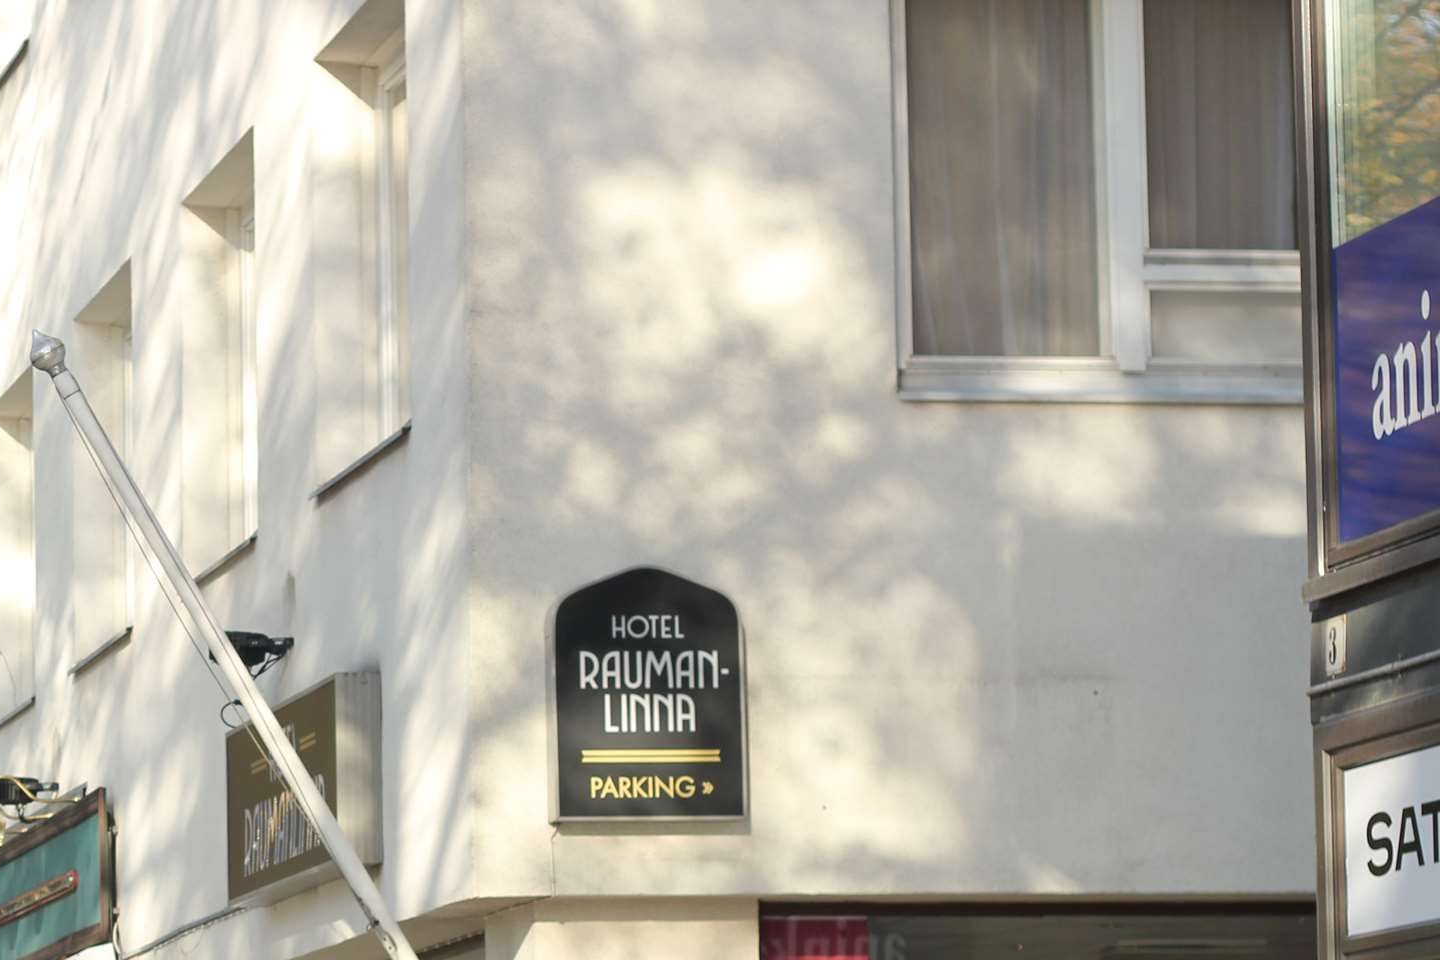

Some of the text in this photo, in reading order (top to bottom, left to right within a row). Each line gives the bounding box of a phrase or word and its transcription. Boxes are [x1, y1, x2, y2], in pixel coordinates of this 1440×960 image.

[611, 614, 685, 639] HOTEL
[1328, 626, 1338, 666] 3
[578, 650, 730, 690] RAUMAN-
[603, 693, 697, 733] LINNA
[589, 776, 696, 799] PARKING
